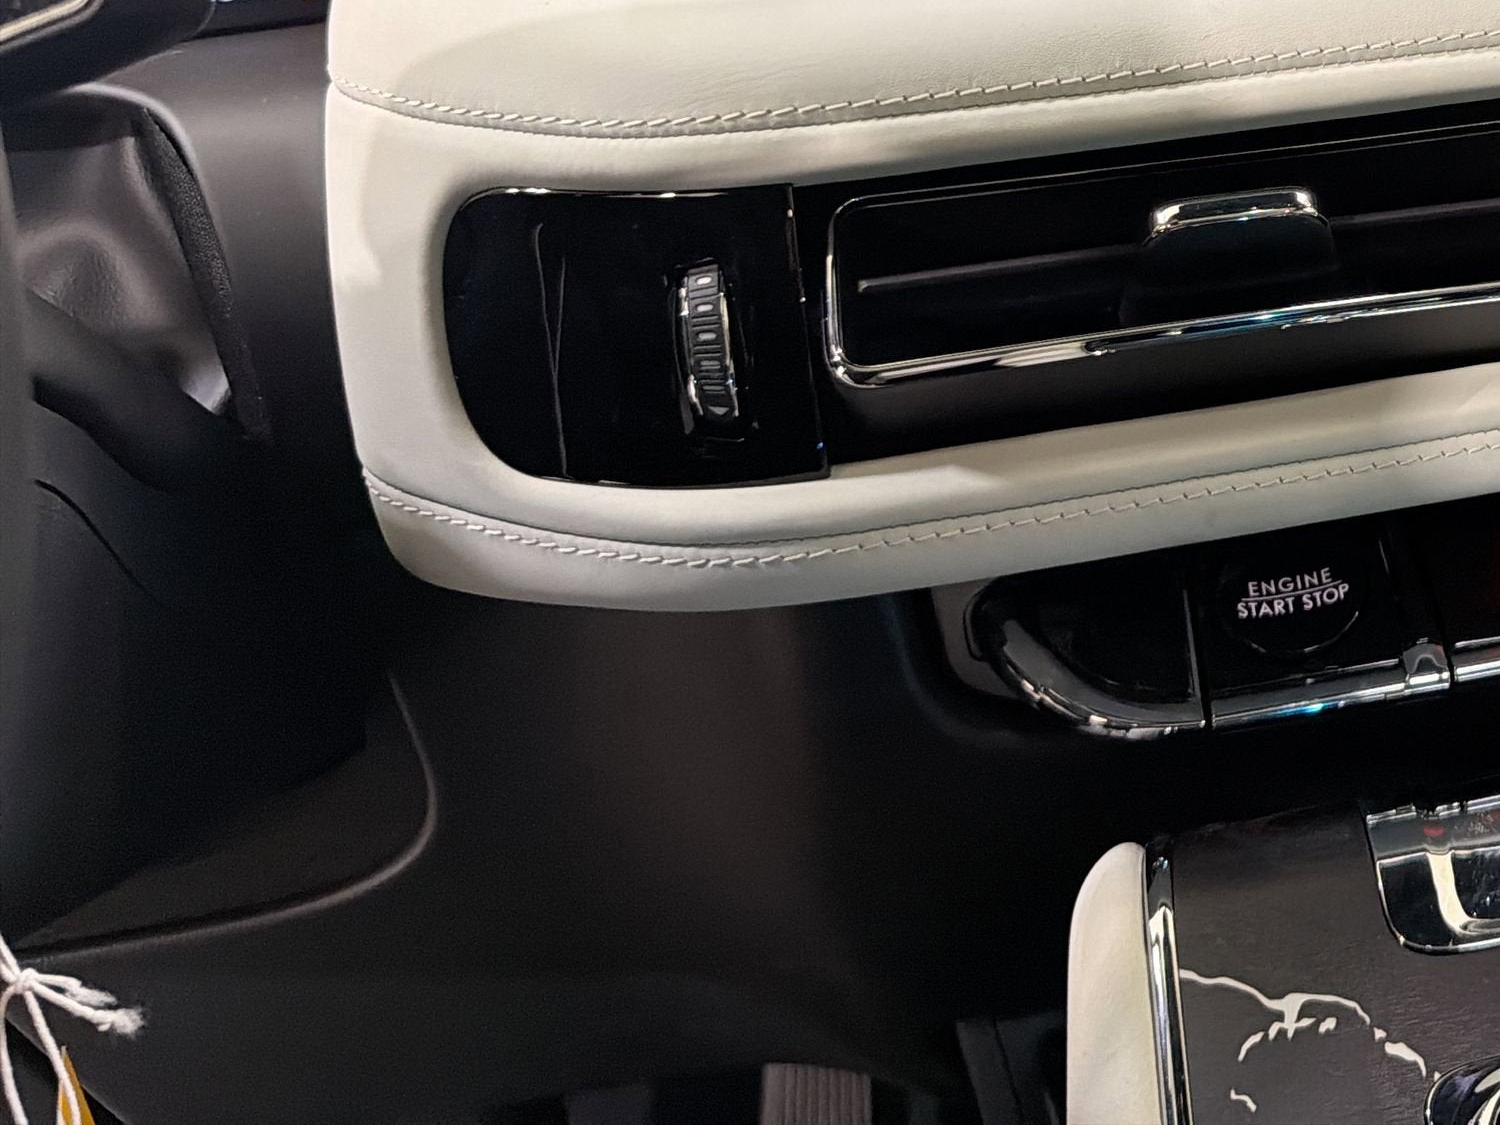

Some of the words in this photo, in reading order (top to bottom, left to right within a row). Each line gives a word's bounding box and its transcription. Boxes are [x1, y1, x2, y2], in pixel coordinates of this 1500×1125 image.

[1247, 566, 1333, 597] ENGINE
[1236, 596, 1296, 619] START
[1301, 582, 1350, 612] STOP
